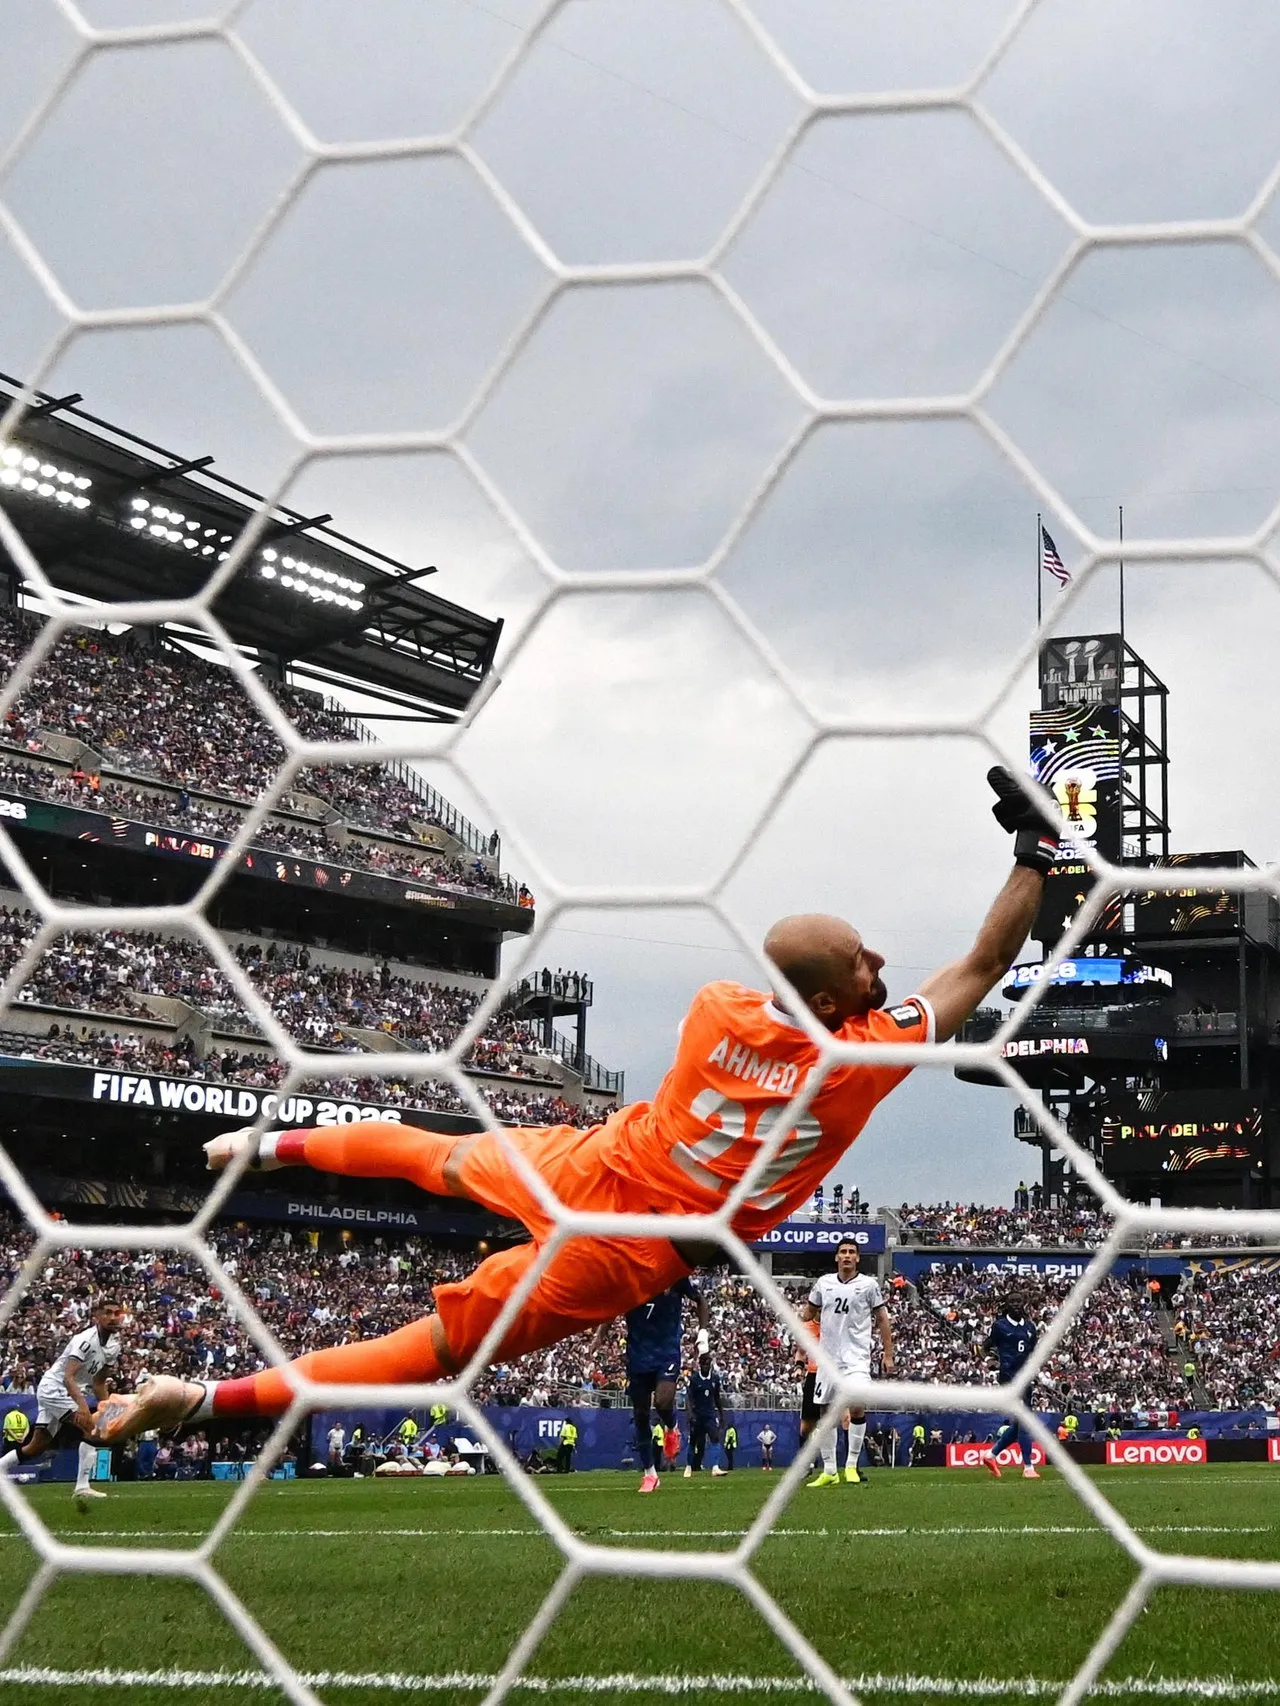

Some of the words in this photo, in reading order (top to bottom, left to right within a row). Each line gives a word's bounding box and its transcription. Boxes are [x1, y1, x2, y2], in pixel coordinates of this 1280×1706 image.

[1017, 961, 1077, 983] 206
[708, 1036, 799, 1095] AHMED
[93, 1073, 155, 1106] FIFA
[159, 1080, 257, 1118] WORLD
[261, 1094, 313, 1124] CUP
[669, 1088, 823, 1211] 22
[288, 1203, 418, 1226] PHILADELPHIA
[784, 1231, 814, 1243] CUP
[646, 1303, 655, 1320] 7
[834, 1297, 849, 1315] 24
[1017, 1340, 1025, 1353] 6
[538, 1420, 568, 1437] FIF
[1110, 1442, 1203, 1463] Lenovo
